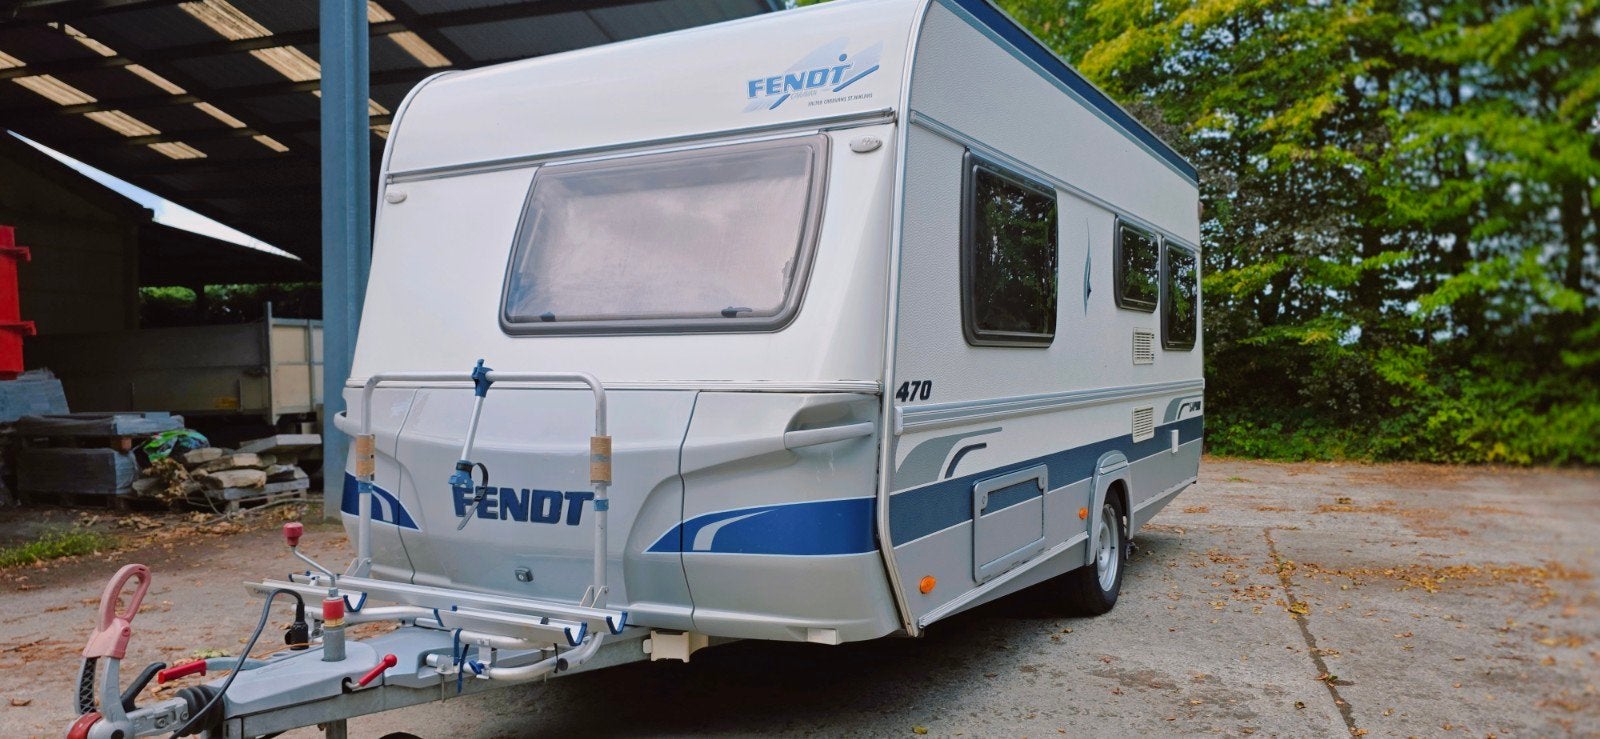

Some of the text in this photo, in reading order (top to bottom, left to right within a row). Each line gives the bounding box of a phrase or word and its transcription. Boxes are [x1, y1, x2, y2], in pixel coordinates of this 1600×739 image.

[748, 64, 852, 98] FENDT
[895, 380, 932, 402] 470
[452, 486, 595, 526] FENDT
